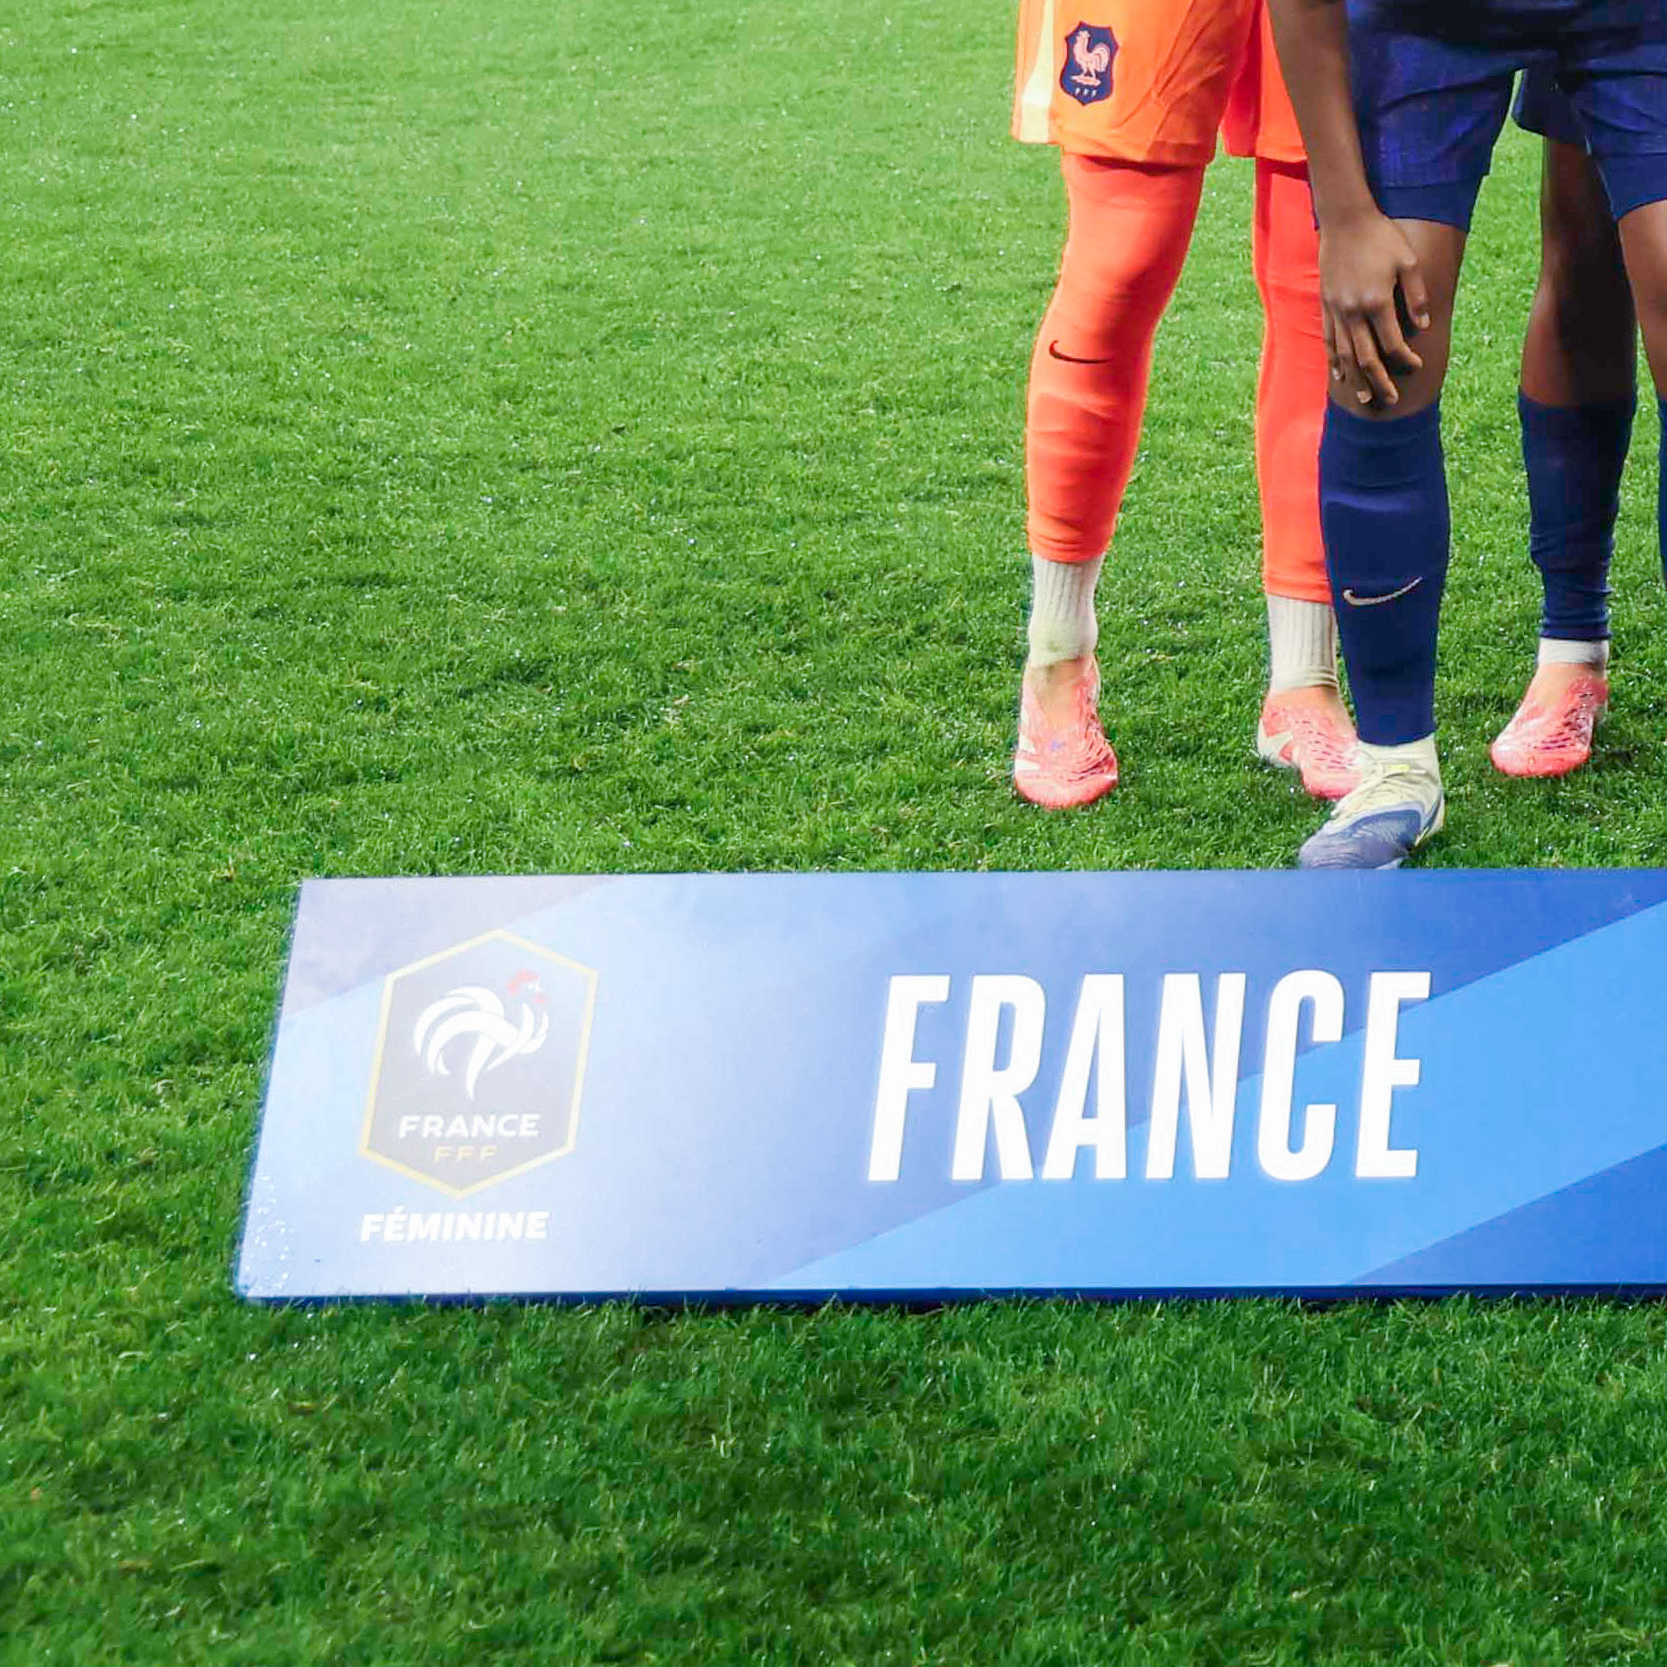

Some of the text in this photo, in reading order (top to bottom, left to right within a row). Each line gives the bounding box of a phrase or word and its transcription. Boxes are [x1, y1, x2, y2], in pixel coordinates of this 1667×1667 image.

[867, 970, 1431, 1181] FRANCE
[398, 1113, 542, 1138] FRANCE
[433, 1145, 499, 1163] FFF
[359, 1205, 550, 1243] FÉMININE
